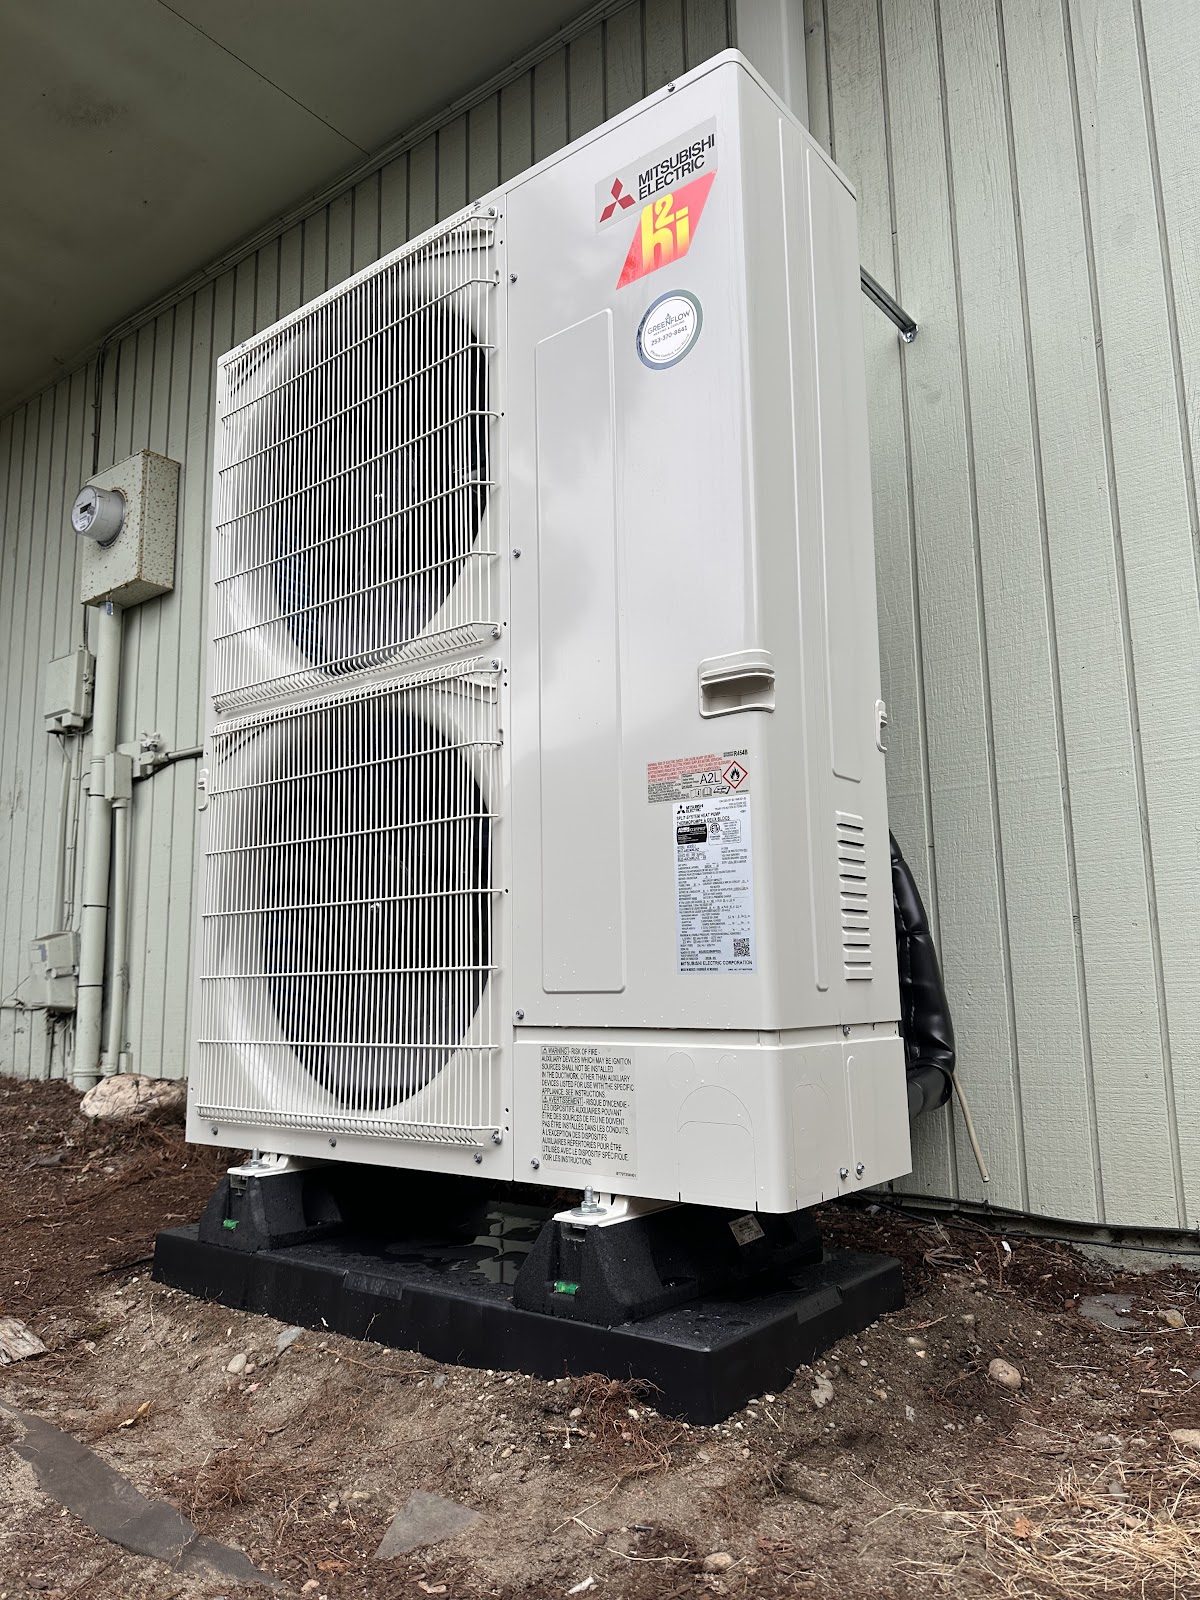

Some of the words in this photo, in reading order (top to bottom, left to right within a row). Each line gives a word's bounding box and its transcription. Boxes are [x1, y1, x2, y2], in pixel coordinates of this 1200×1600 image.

[638, 133, 715, 188] MITSUBISHI
[638, 154, 705, 200] ELECTRIC
[647, 309, 691, 335] GREENFLOW
[700, 772, 720, 784] A2L
[608, 1074, 630, 1082] AUXILIARY
[614, 1083, 634, 1091] SPECIFIC
[549, 1096, 581, 1104] AVERTISSEMENT
[603, 1099, 627, 1107] D'INCENDIE
[576, 1106, 601, 1114] AUXILIAIRES
[562, 1113, 582, 1122] SOURCES
[590, 1115, 598, 1123] FEU
[606, 1116, 624, 1125] DOIVENT
[585, 1123, 596, 1131] DANS
[597, 1124, 605, 1132] LES
[546, 1128, 571, 1137] L'EXCEPTION
[572, 1130, 580, 1138] DES
[582, 1131, 607, 1141] DISPOSITIFS
[542, 1137, 566, 1146] AUXILIAIRES
[597, 1142, 609, 1150] POUR
[561, 1147, 571, 1155] AVEC
[579, 1149, 601, 1158] DISPOSITIF
